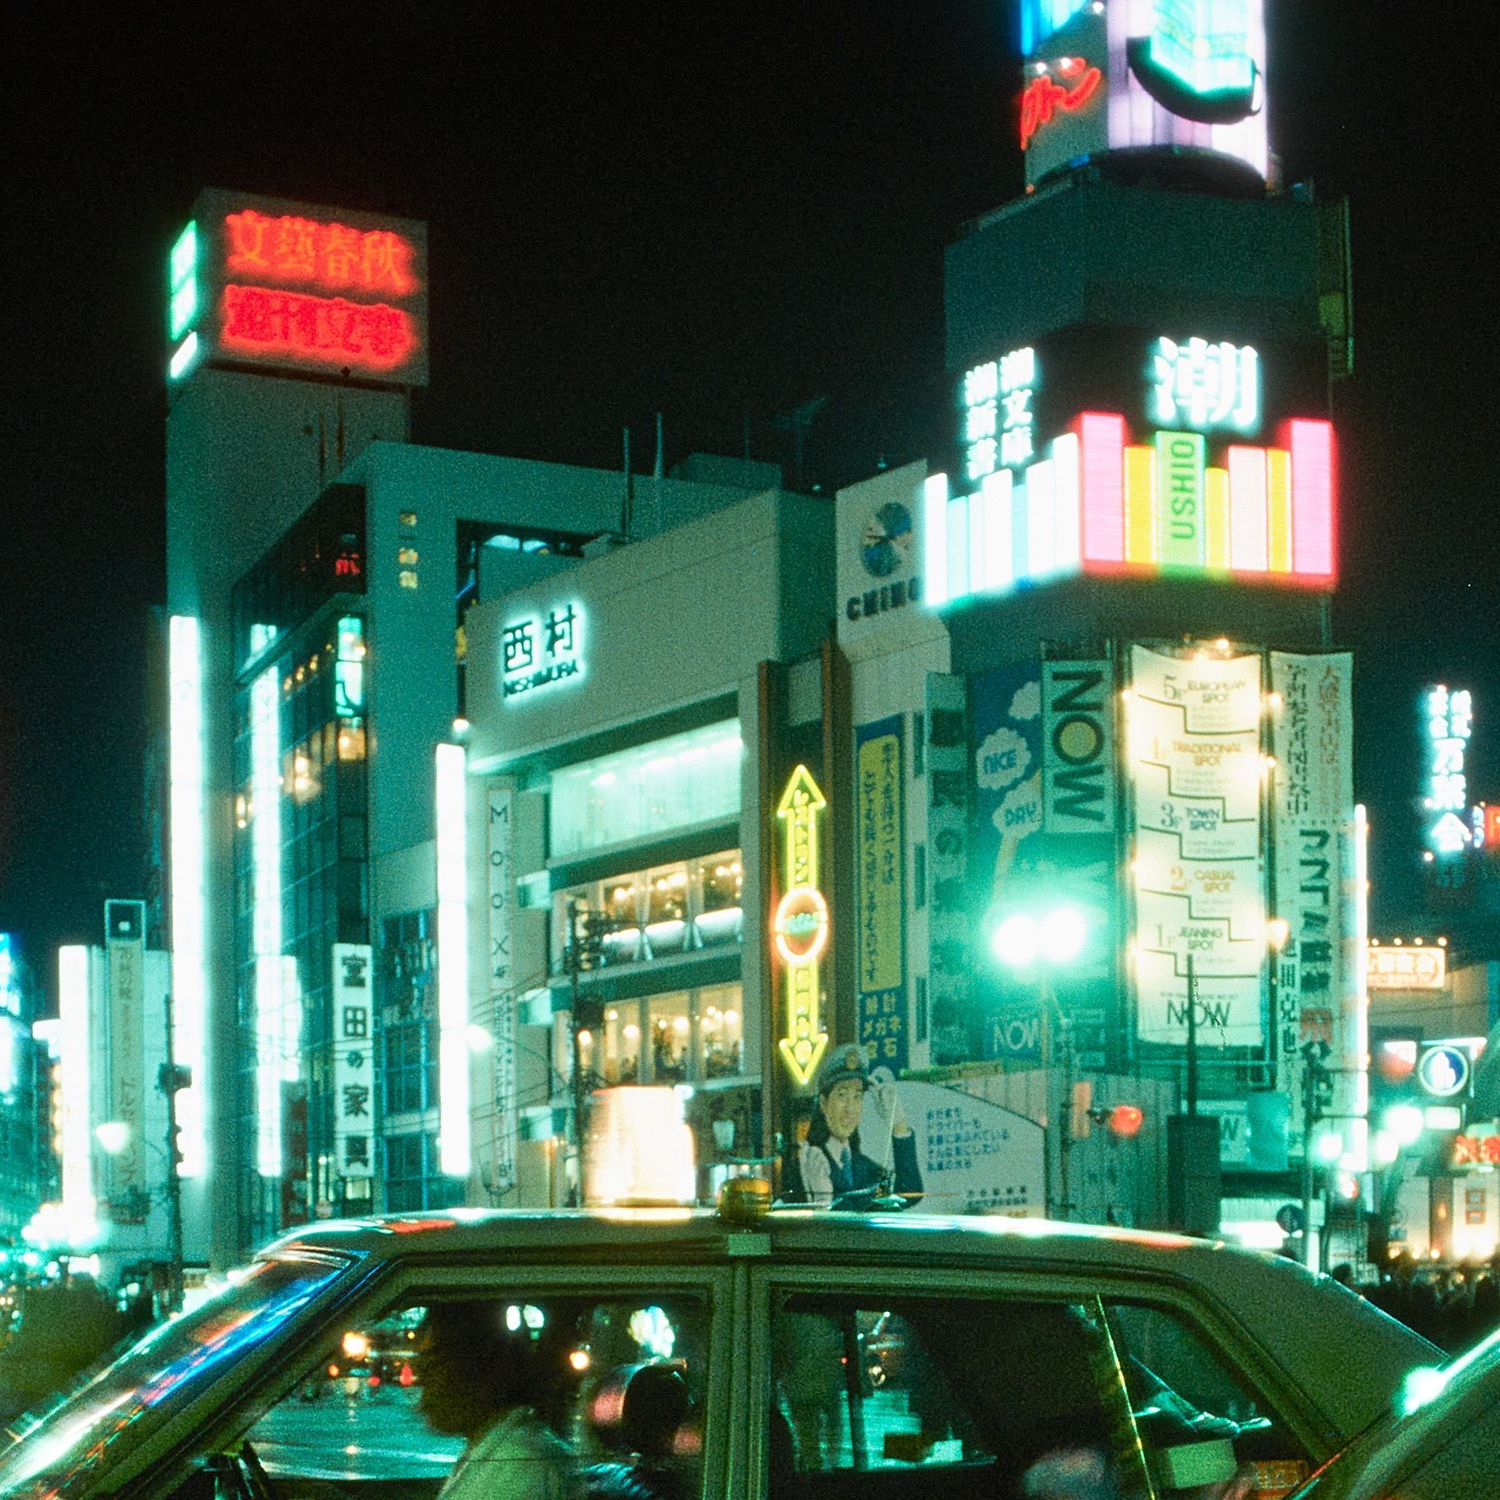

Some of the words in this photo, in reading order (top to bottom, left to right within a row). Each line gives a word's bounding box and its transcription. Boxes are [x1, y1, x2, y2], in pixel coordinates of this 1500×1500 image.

[224, 209, 408, 288] 文藝春秋
[1169, 438, 1196, 543] USHIO
[502, 602, 578, 674] 西村
[1187, 679, 1246, 694] EUROPEAN
[1202, 691, 1230, 704] SPOT
[1051, 670, 1107, 823] NOW
[1172, 740, 1243, 755] TRADITIONAL
[1194, 755, 1222, 768] SPOT
[1187, 806, 1220, 819] TOWN
[1189, 818, 1218, 832] SPOT
[1194, 868, 1236, 882] CASUAL
[1203, 880, 1231, 894] SPOT
[1187, 937, 1215, 951] SPOT
[1167, 1000, 1232, 1028] NOW
